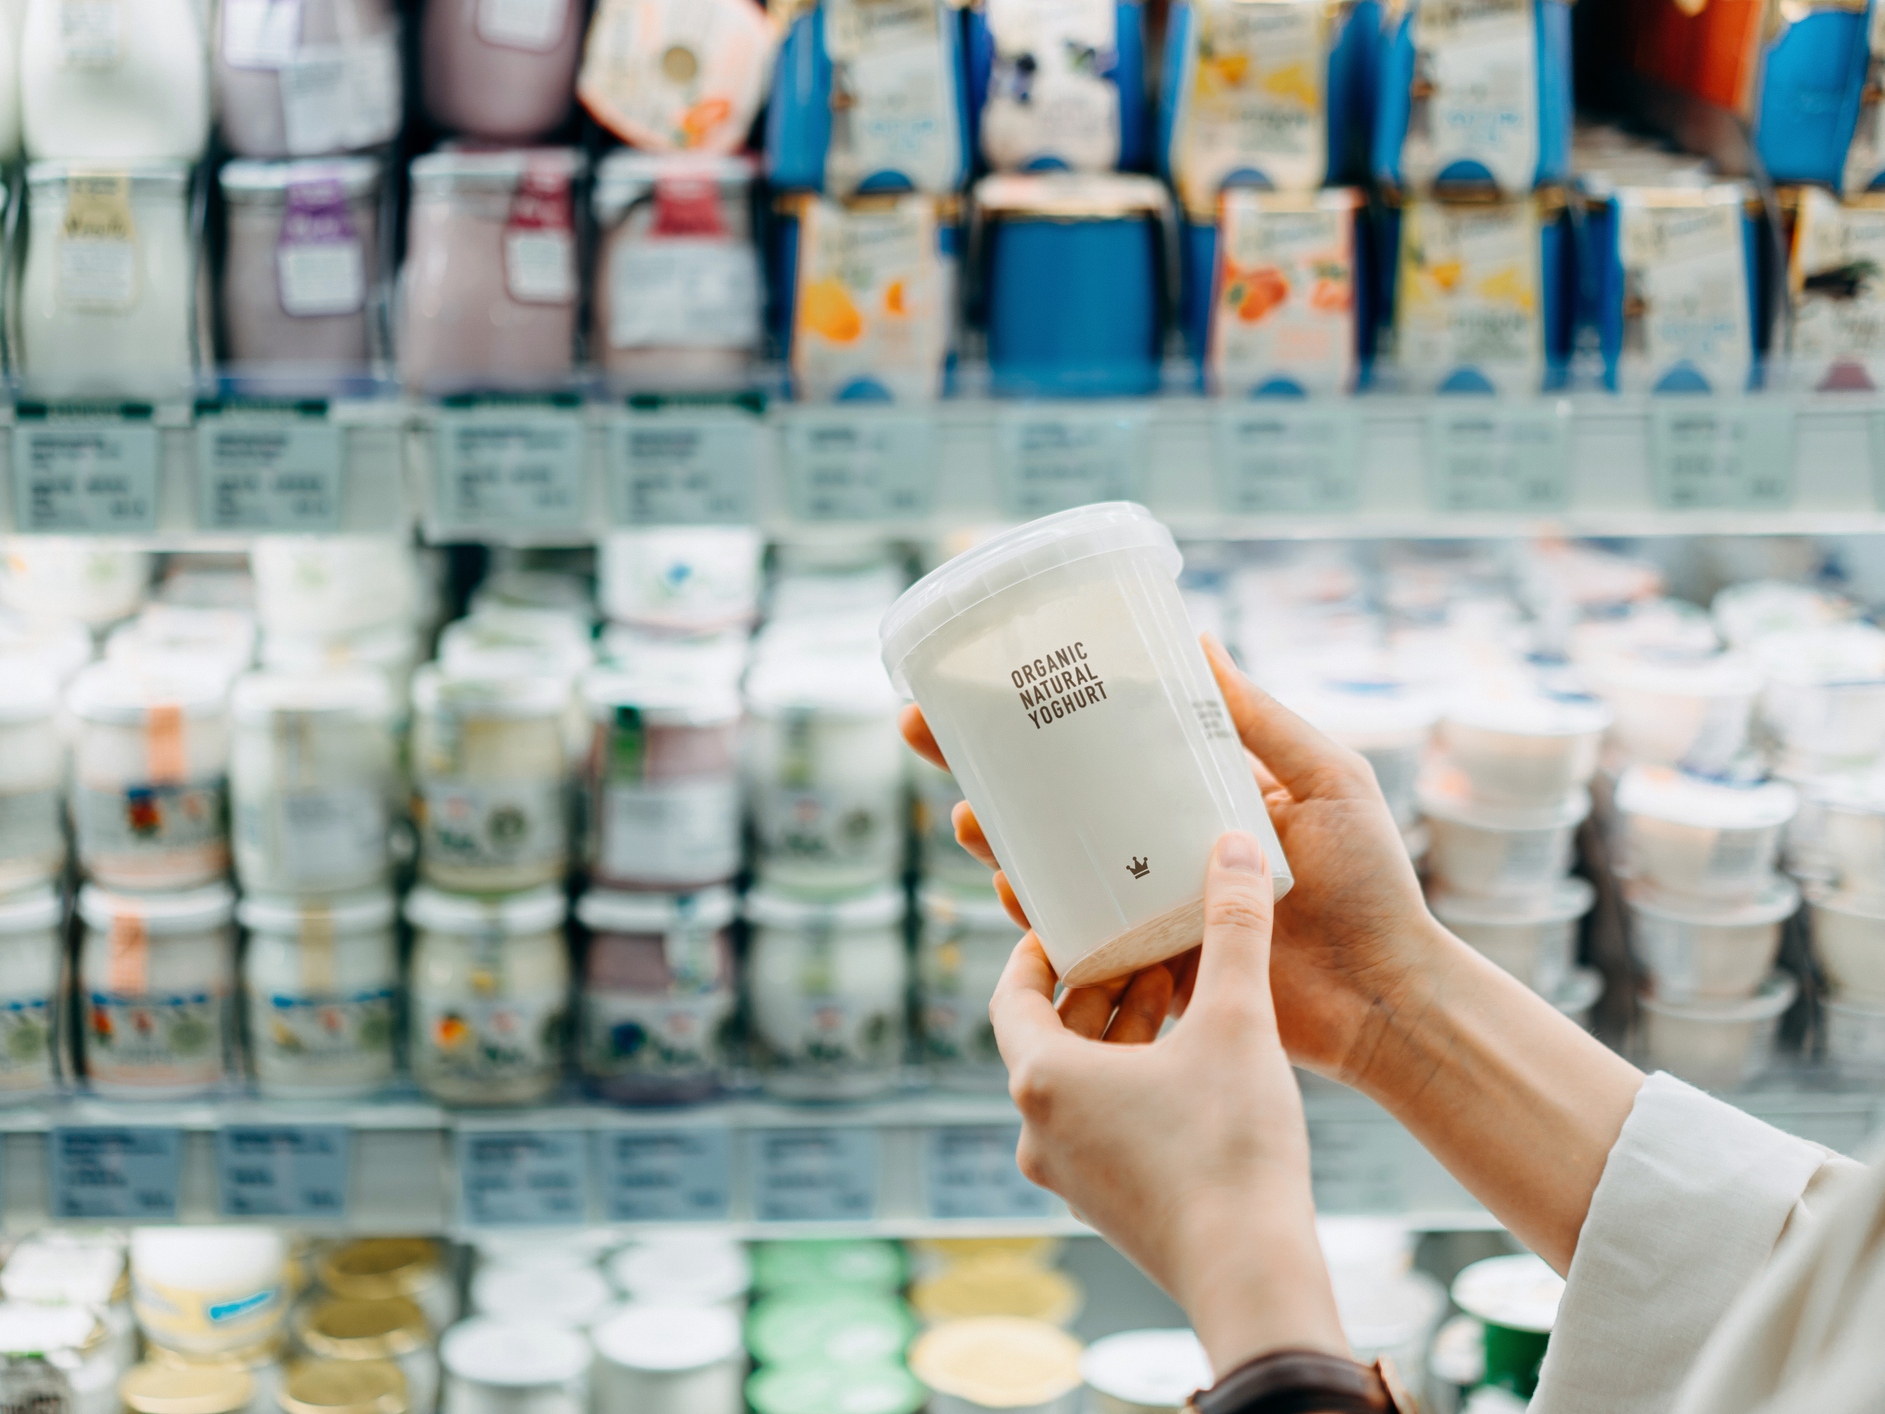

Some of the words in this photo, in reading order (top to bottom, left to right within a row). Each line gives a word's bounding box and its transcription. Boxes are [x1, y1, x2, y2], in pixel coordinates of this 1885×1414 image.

[1011, 641, 1088, 689] ORGANIC
[1019, 662, 1099, 711] NATURAL
[1028, 681, 1108, 730] YOGHURT
